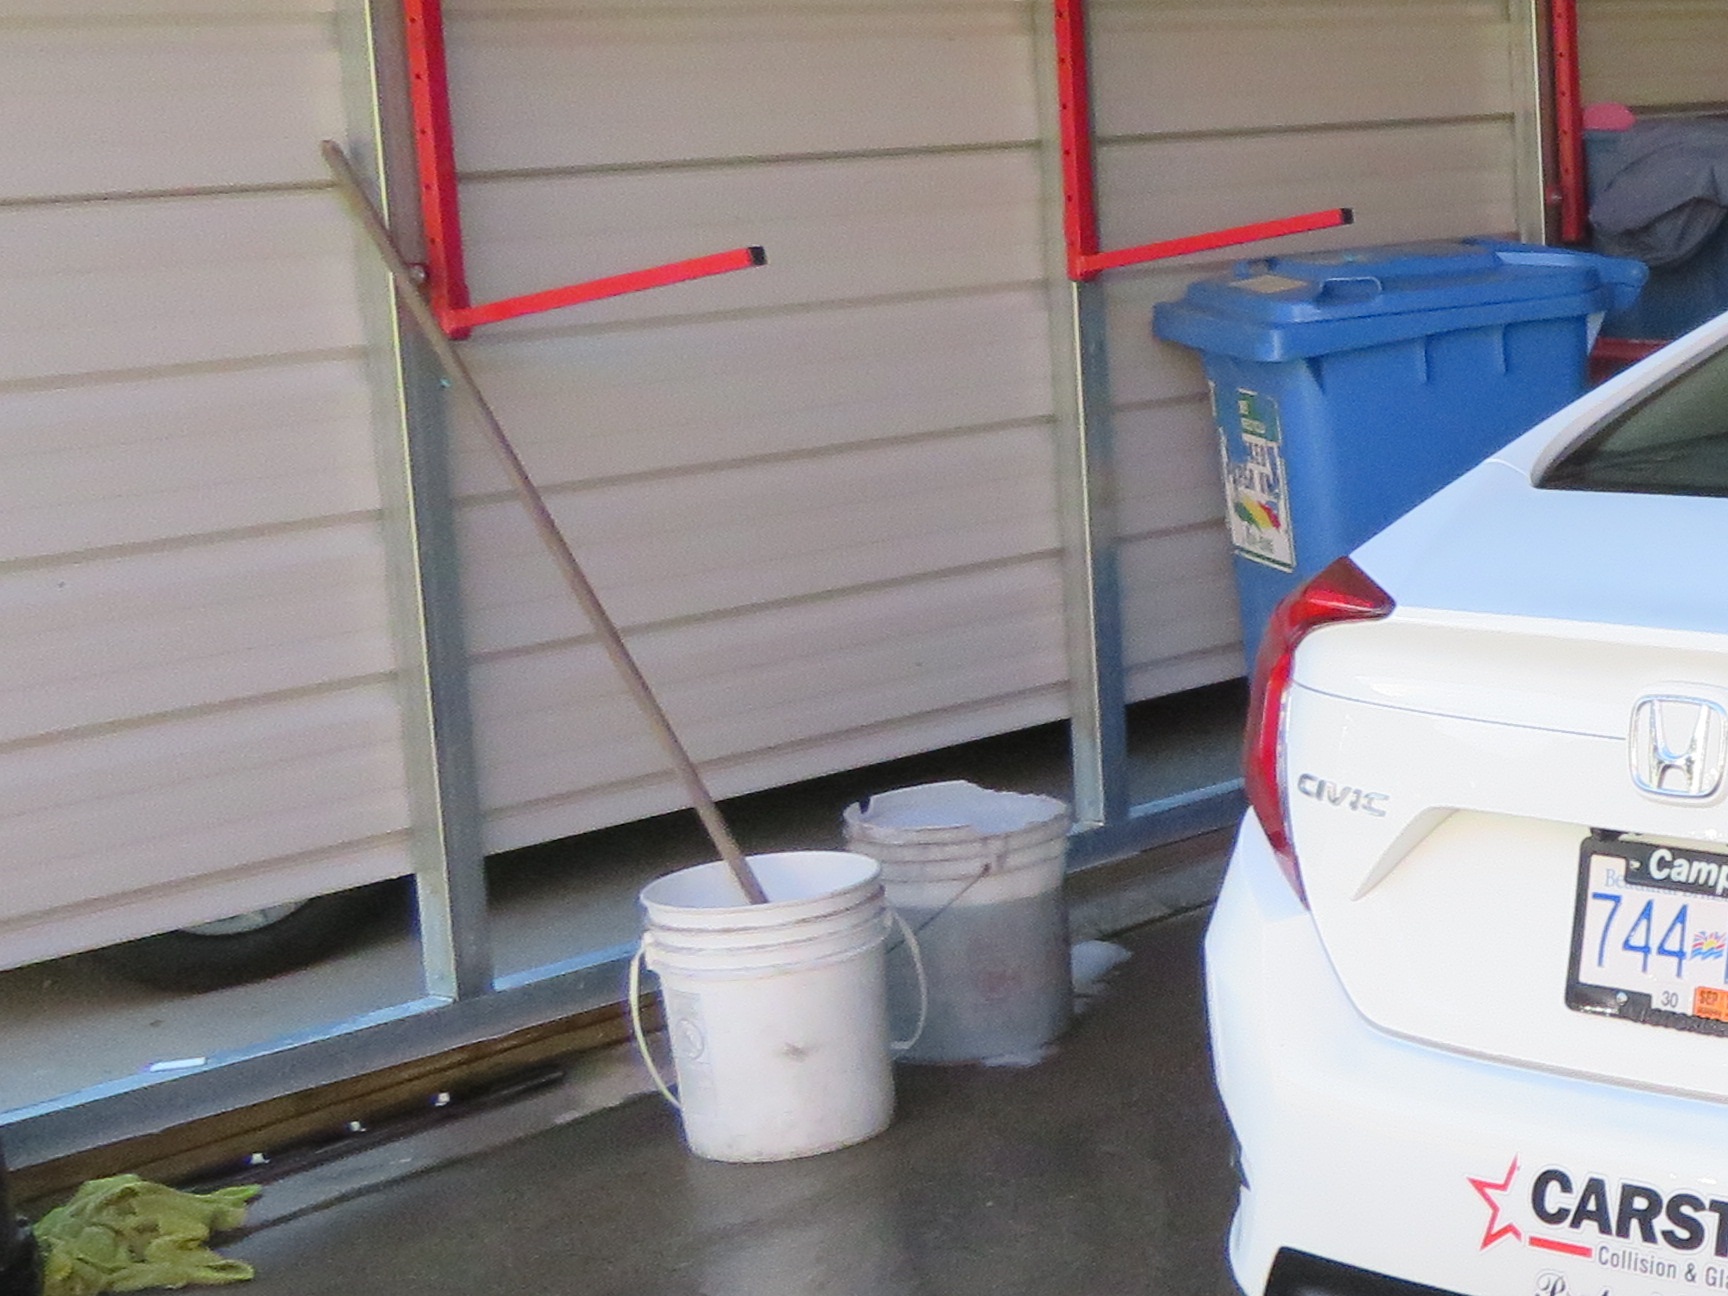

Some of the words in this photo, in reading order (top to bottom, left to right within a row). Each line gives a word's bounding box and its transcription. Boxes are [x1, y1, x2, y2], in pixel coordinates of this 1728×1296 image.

[1297, 772, 1390, 817] CIVIC
[1591, 891, 1689, 978] 744
[1660, 990, 1679, 1009] 30
[1699, 989, 1719, 1005] SEP
[1598, 1245, 1678, 1279] Collision
[1684, 1262, 1698, 1283] &
